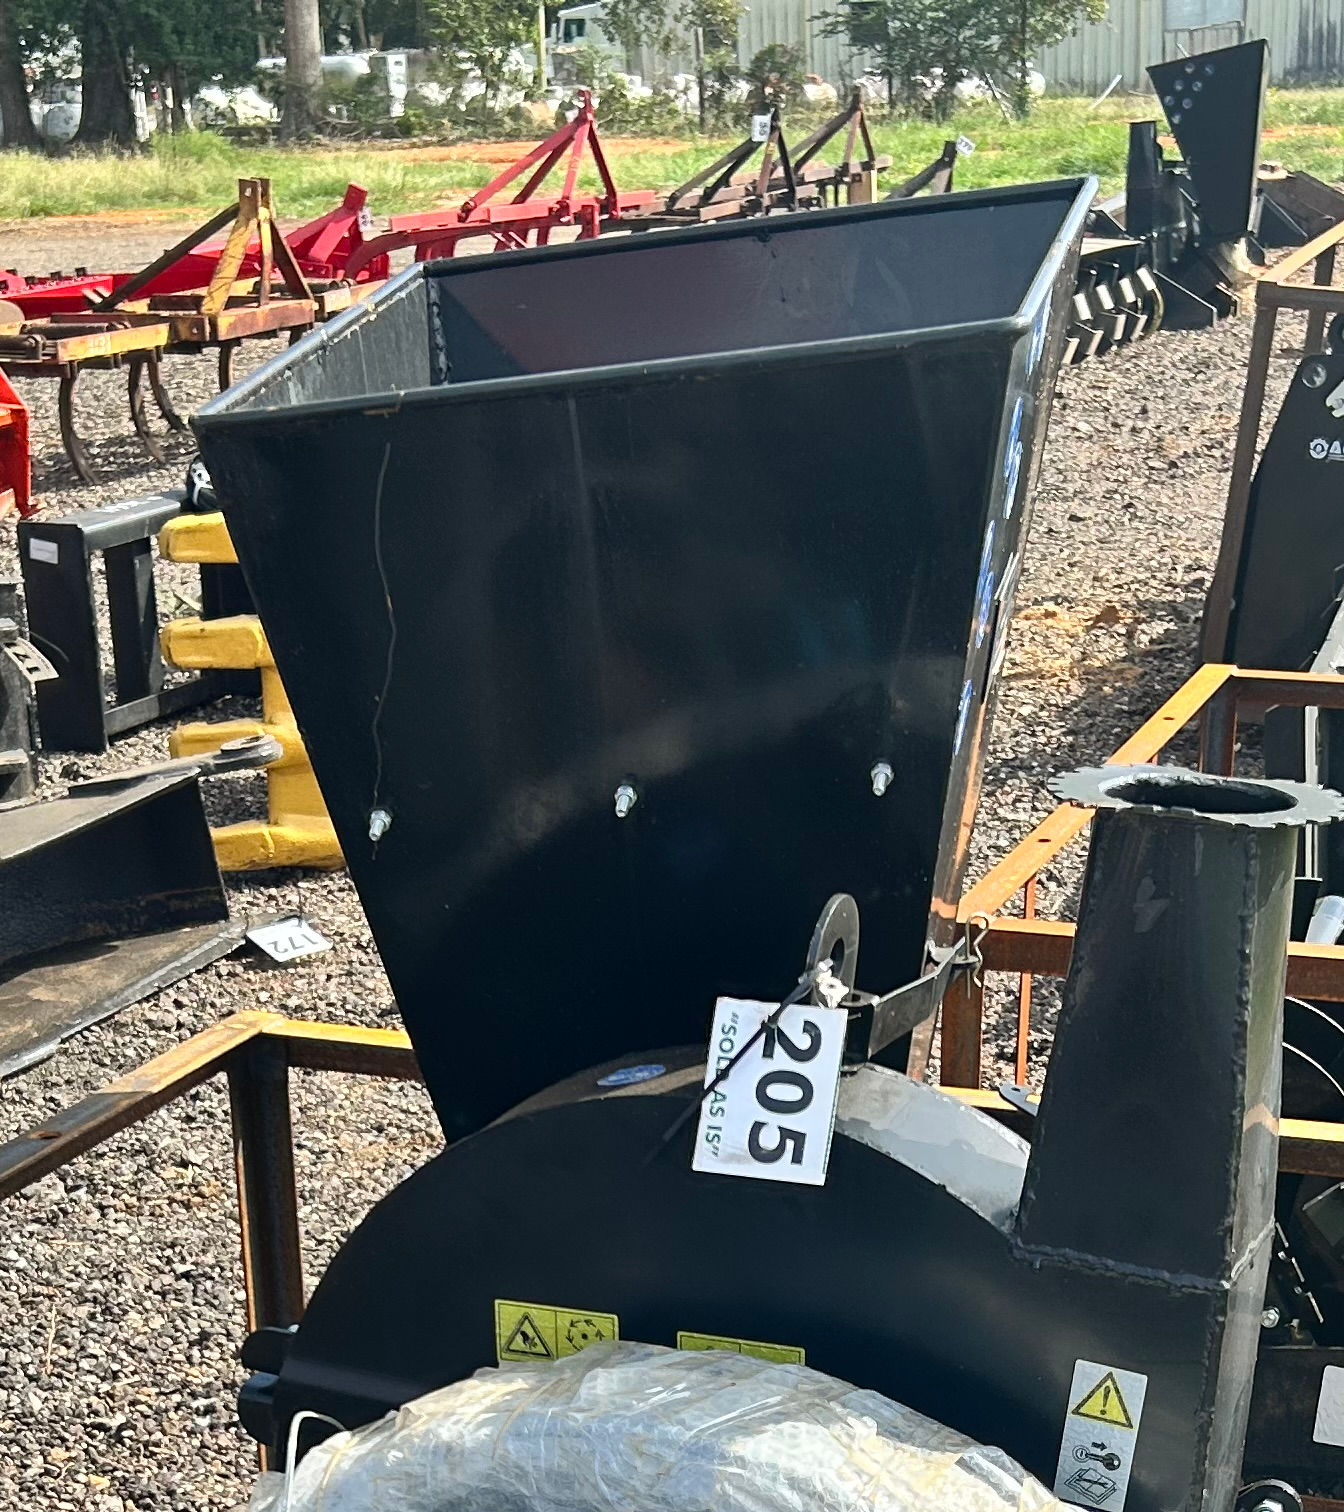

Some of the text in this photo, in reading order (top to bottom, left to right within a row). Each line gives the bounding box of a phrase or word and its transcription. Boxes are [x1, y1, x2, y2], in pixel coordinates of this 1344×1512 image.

[267, 933, 319, 954] 172
[708, 1089, 728, 1118] AS
[747, 1019, 823, 1165] 205
